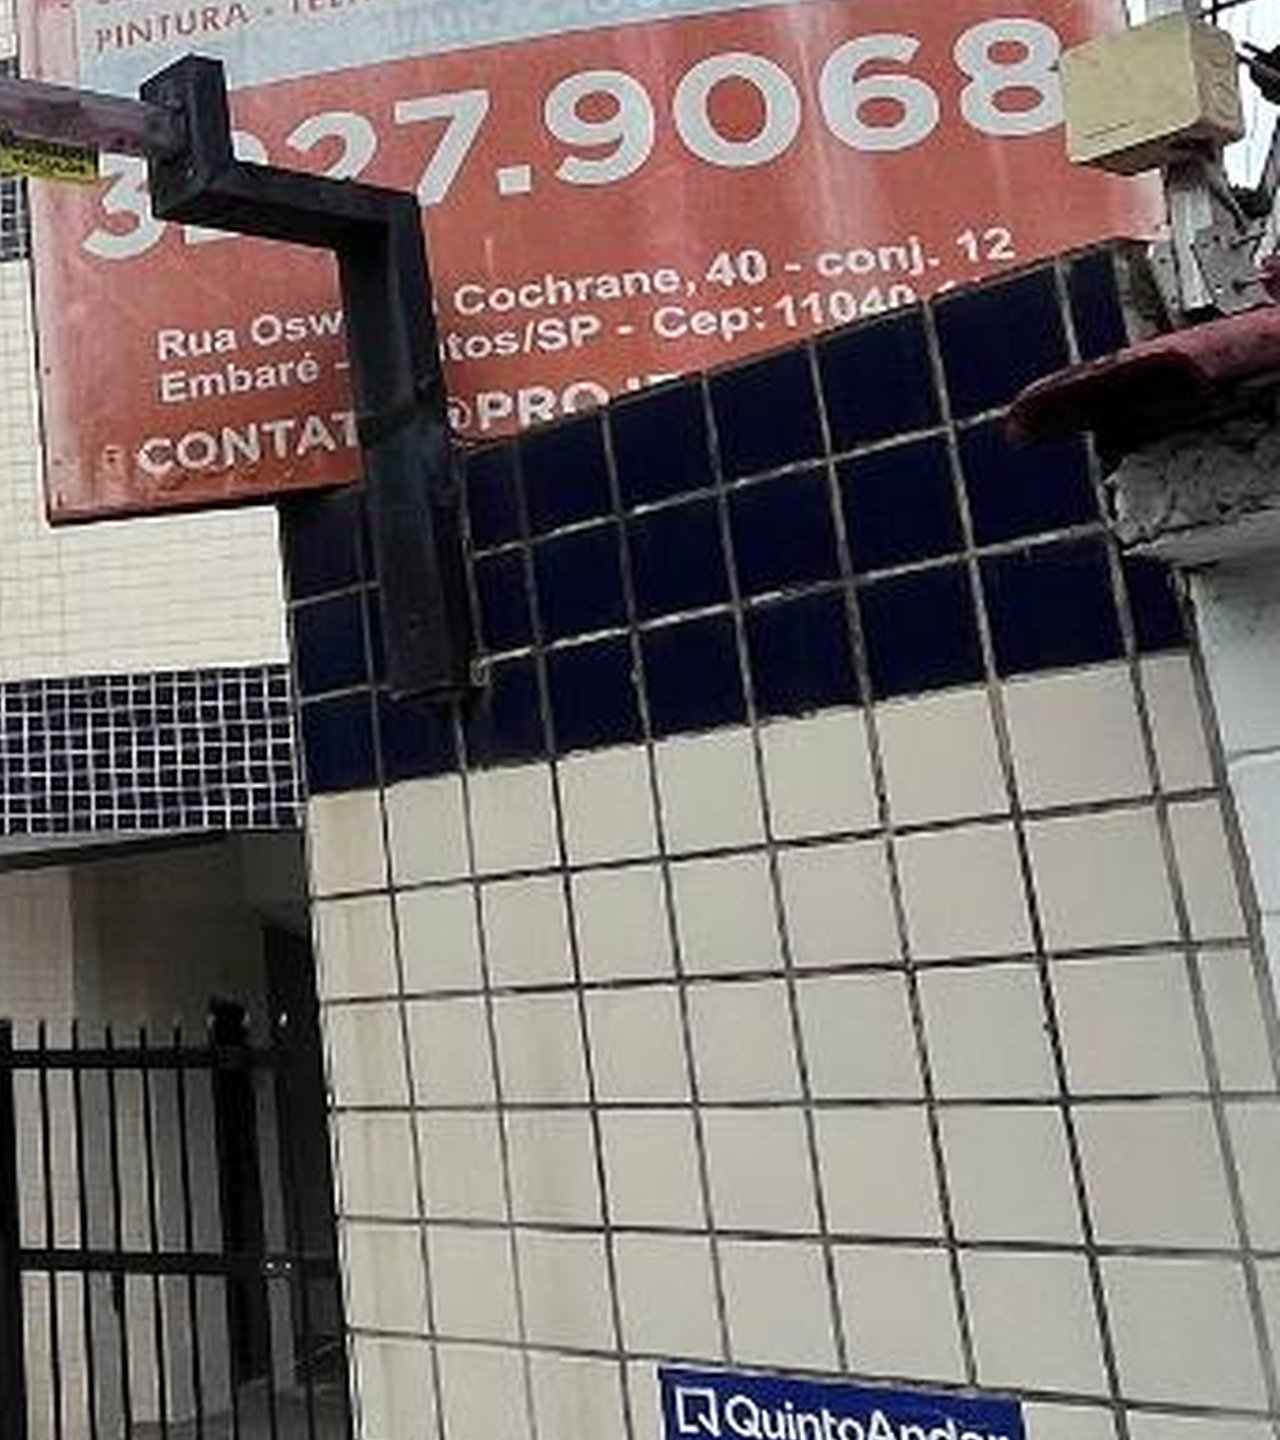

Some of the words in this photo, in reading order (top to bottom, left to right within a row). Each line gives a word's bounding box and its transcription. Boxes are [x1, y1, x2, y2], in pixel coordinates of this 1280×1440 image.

[94, 2, 250, 54] PINTURA
[157, 328, 238, 361] Rua
[453, 268, 696, 315] Cochrane,
[706, 250, 768, 286] 40
[816, 236, 940, 276] conj.
[956, 227, 1016, 262] 12
[160, 351, 320, 403] Embaré
[440, 314, 602, 361] tos/SP
[653, 306, 765, 341] Cep:
